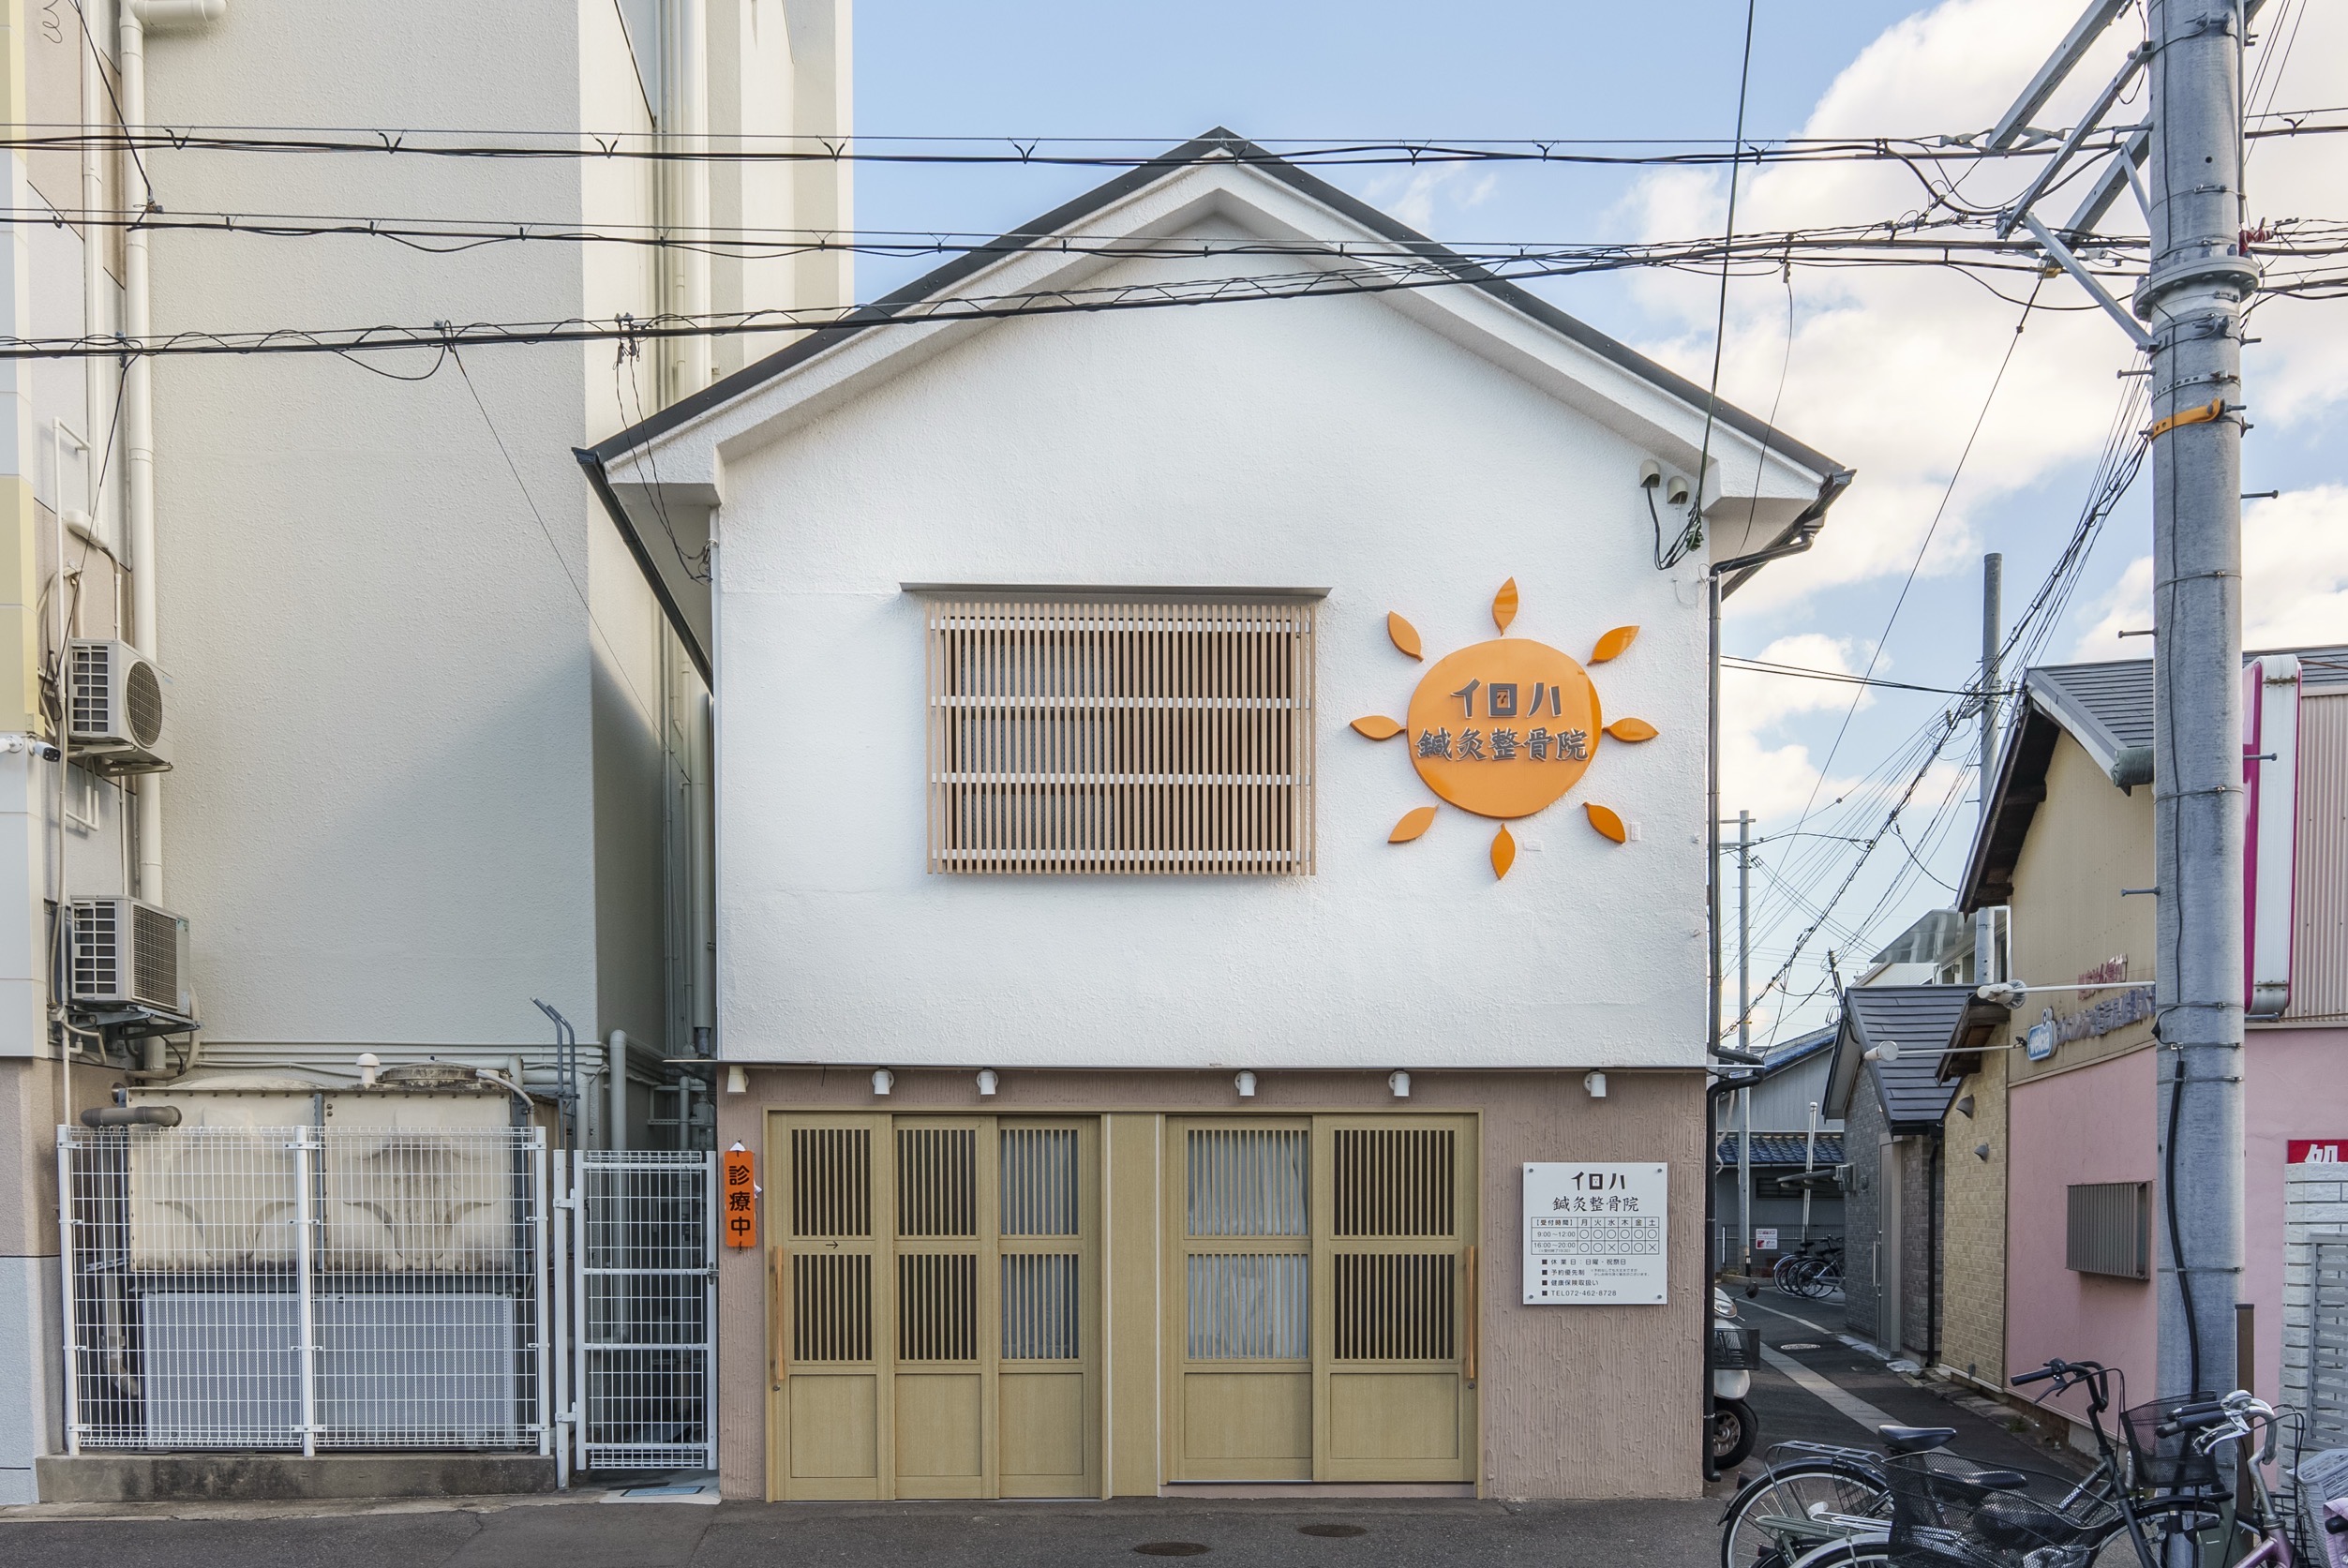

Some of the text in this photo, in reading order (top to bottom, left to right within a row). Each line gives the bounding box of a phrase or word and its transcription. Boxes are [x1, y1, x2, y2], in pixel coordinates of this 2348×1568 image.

[1450, 678, 1563, 720] イロハ
[1414, 726, 1589, 762] 鍼灸整骨院
[1571, 1172, 1625, 1190] イロハ
[728, 1164, 751, 1237] 診療中
[1552, 1196, 1639, 1212] 鍼灸整骨院
[1580, 1218, 1588, 1227] 月
[1594, 1218, 1602, 1227] 火
[1608, 1218, 1616, 1227] 水
[1621, 1218, 1629, 1227] 木
[1635, 1218, 1643, 1227] 金
[1648, 1218, 1656, 1227] 土
